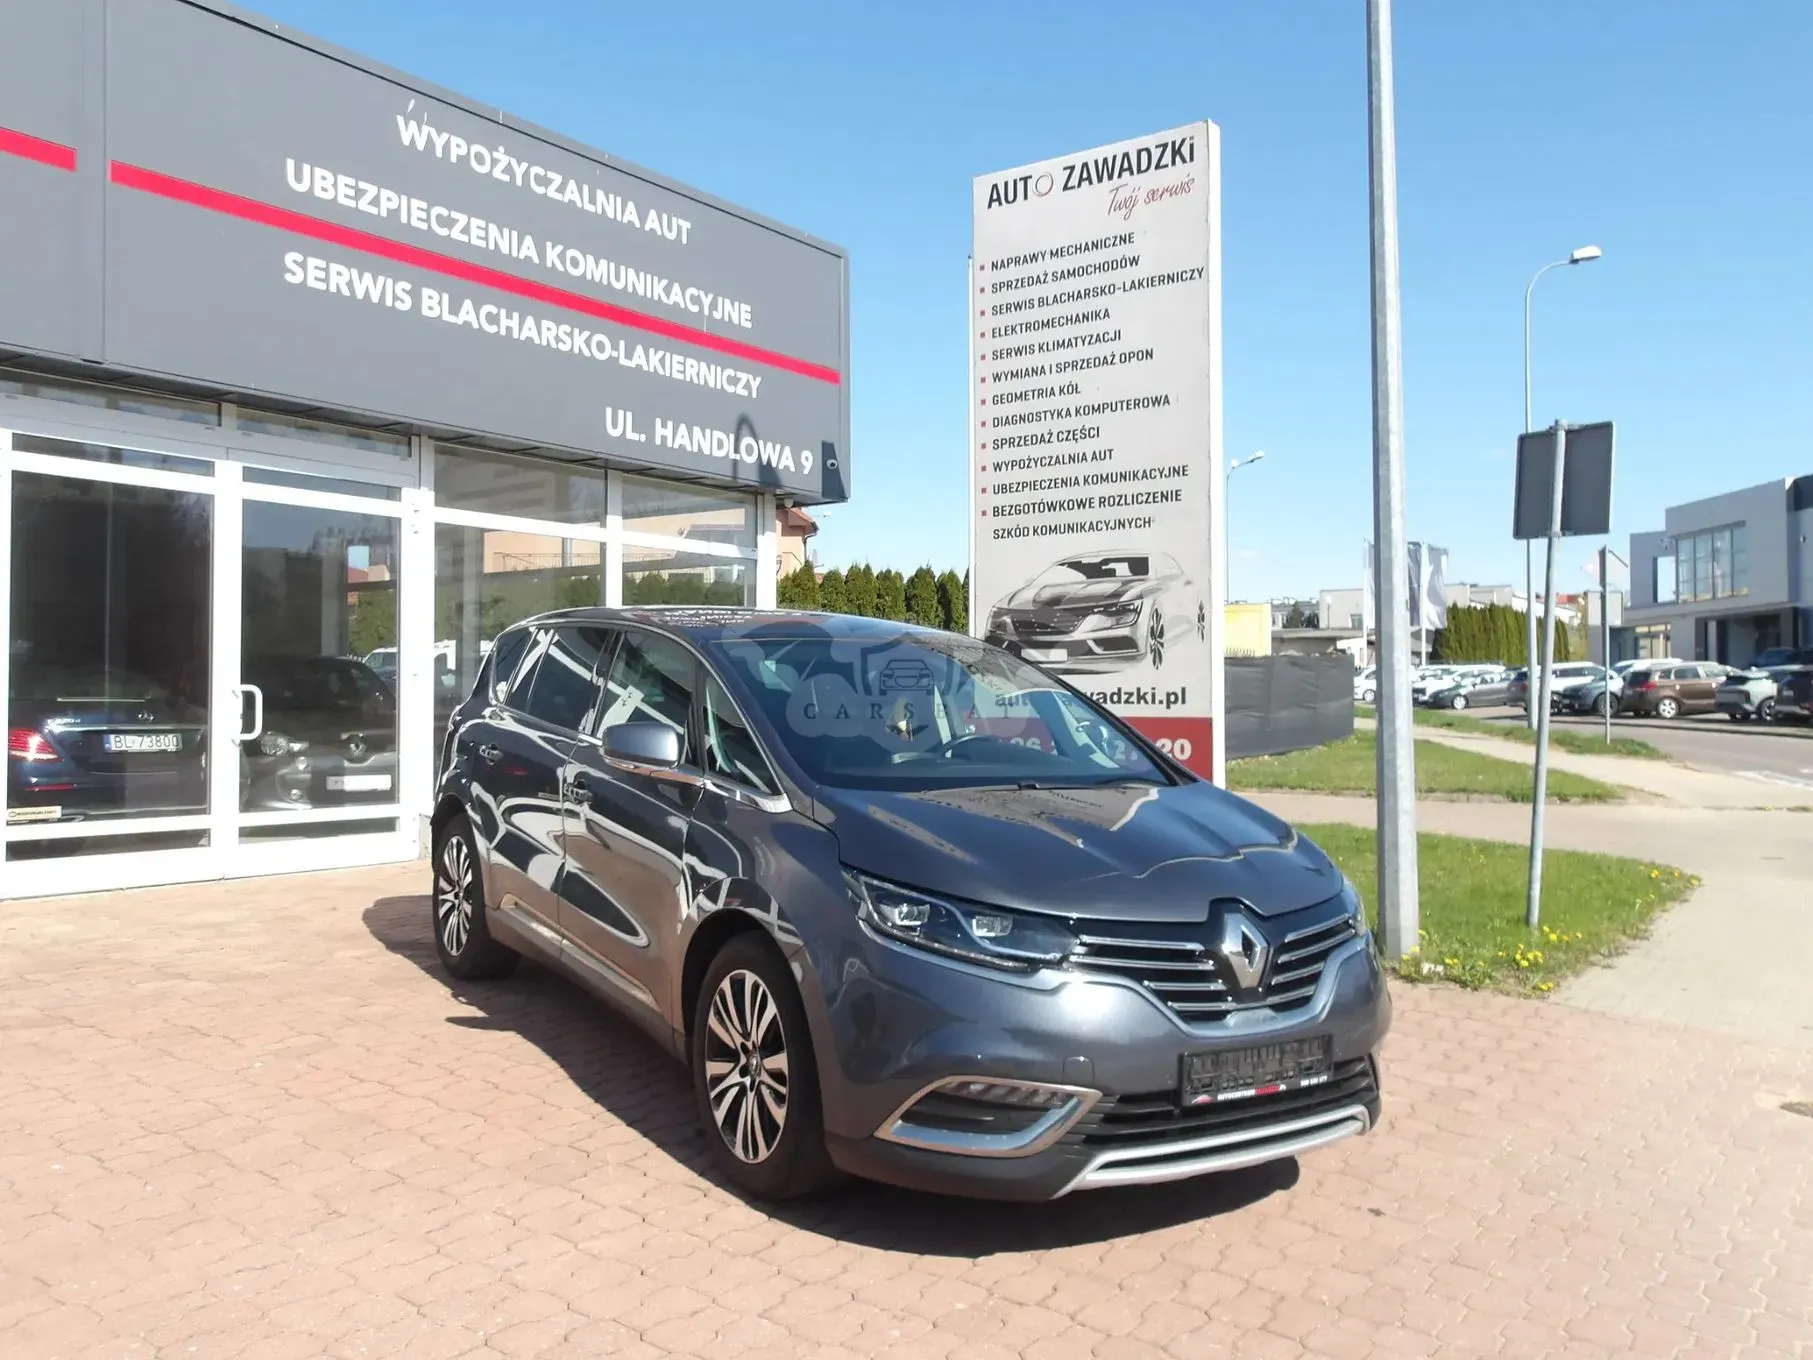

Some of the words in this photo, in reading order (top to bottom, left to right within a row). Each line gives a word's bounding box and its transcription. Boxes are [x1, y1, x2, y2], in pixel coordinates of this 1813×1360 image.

[397, 113, 640, 229] WYPOŻYCZALNIA
[645, 211, 692, 245] AUT
[986, 172, 1054, 210] AUTO
[1107, 183, 1140, 220] Twój
[285, 158, 539, 264] UBEZPIECZENIA
[545, 243, 752, 328] KOMUNIKACYJNE
[991, 251, 1049, 272] NAPRAWY
[1050, 232, 1135, 259] MECHANICZNE
[991, 270, 1048, 294] SPRZEDAŻ
[1051, 255, 1140, 282] SAMOCHODÓW
[992, 299, 1035, 316] SERWIS
[1038, 267, 1204, 307] BLACHARSKO-LAKIERNICZY
[284, 252, 411, 310] SERWIS
[421, 286, 761, 399] BLACHARSKO-LAKIERNICZY
[992, 308, 1110, 339] ELEKTROMECHANIKA
[992, 342, 1035, 361] SERWIS
[1038, 329, 1122, 353] KLIMATYZACJI
[992, 365, 1046, 383] WYMIANA
[1049, 363, 1053, 375] I
[1056, 351, 1116, 374] SPRZEDAŻ
[1119, 348, 1154, 364] OPON
[992, 386, 1056, 406] GEOMETRIA
[1059, 383, 1081, 397] KÓŁ
[992, 408, 1072, 428] DIAGNOSTYKA
[1075, 394, 1170, 417] KOMPUTEROWA
[605, 407, 646, 442] UL.
[655, 418, 795, 473] HANDLOWA
[801, 450, 813, 475] 9
[992, 429, 1054, 450] SPRZEDAŻ
[1057, 425, 1100, 444] CZĘŚCI
[993, 452, 1088, 473] WYPOŻYCZALNIA
[1091, 449, 1114, 462] AUT
[993, 474, 1080, 495] UBEZPIECZENIA
[1083, 465, 1189, 486] KOMUNIKACYJNE
[993, 496, 1095, 518] BEZGOTÓWKOWE
[1099, 489, 1182, 509] ROZLICZENIE
[993, 524, 1029, 540] SZKÓD
[1033, 517, 1151, 537] KOMUNIKACYJNYCH
[114, 735, 132, 749] BL
